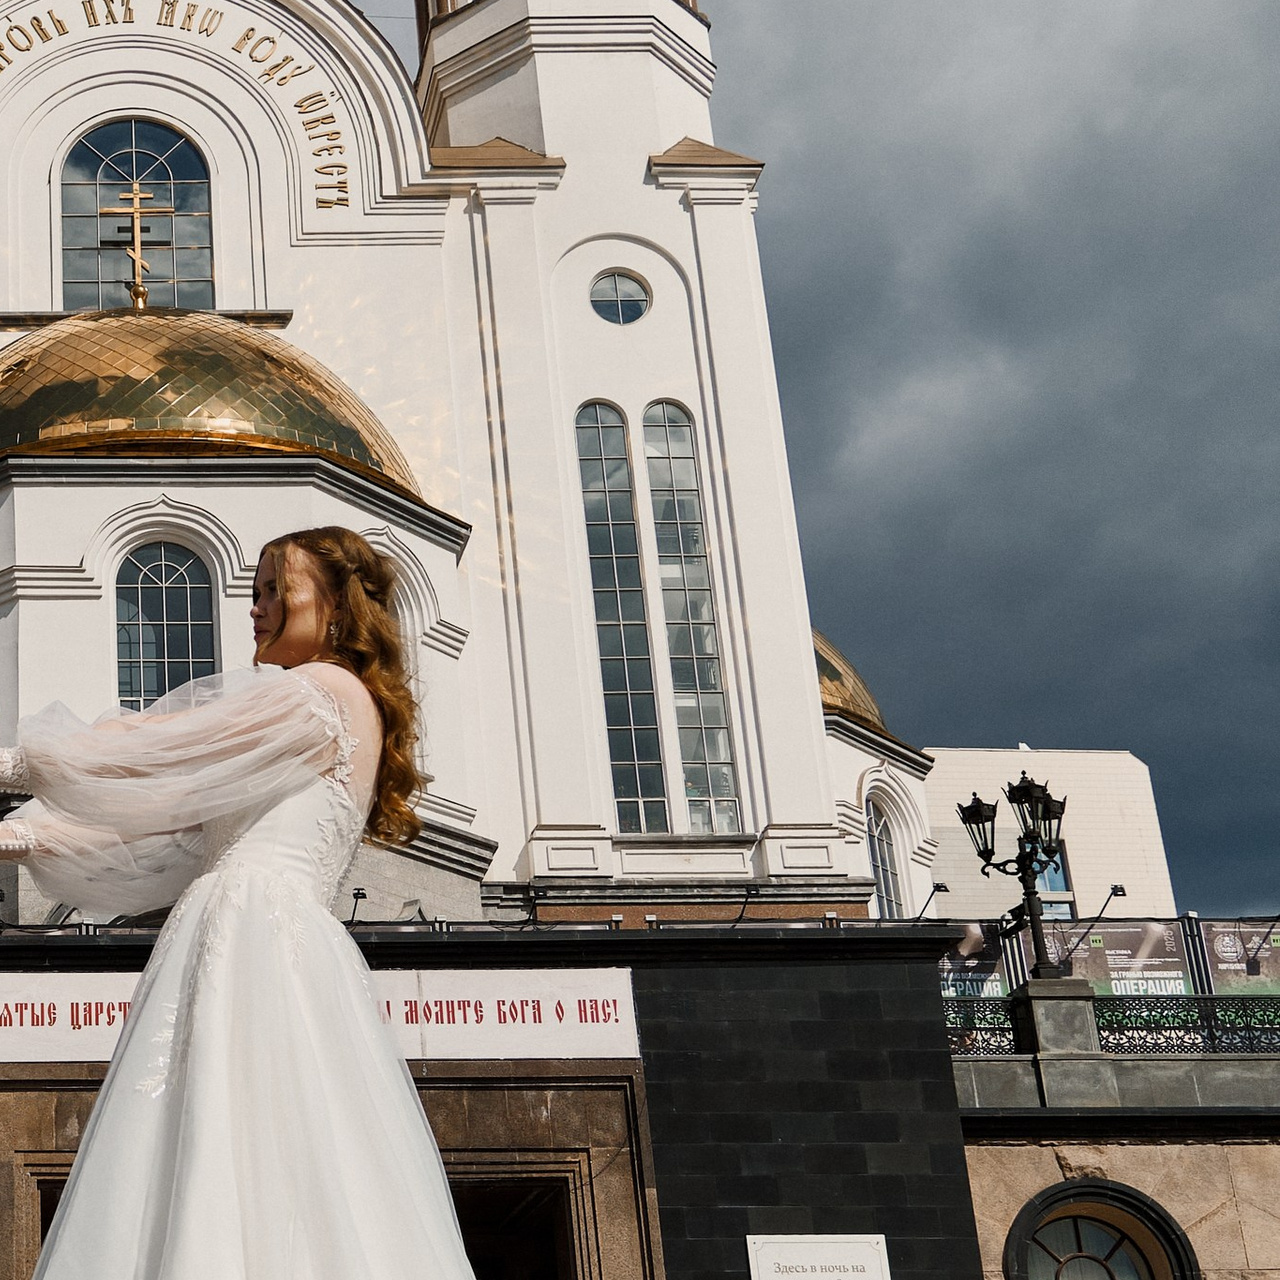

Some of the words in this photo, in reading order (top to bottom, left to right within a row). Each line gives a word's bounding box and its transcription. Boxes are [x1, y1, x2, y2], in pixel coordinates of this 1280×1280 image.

[1111, 980, 1186, 995] ОПЕРАЦИЯ
[496, 999, 542, 1024] БОГА
[555, 999, 565, 1024] О
[577, 999, 619, 1024] НАС!
[773, 1262, 808, 1275] Здесь
[810, 1264, 817, 1273] в
[820, 1264, 849, 1273] ночь
[851, 1264, 866, 1273] на
